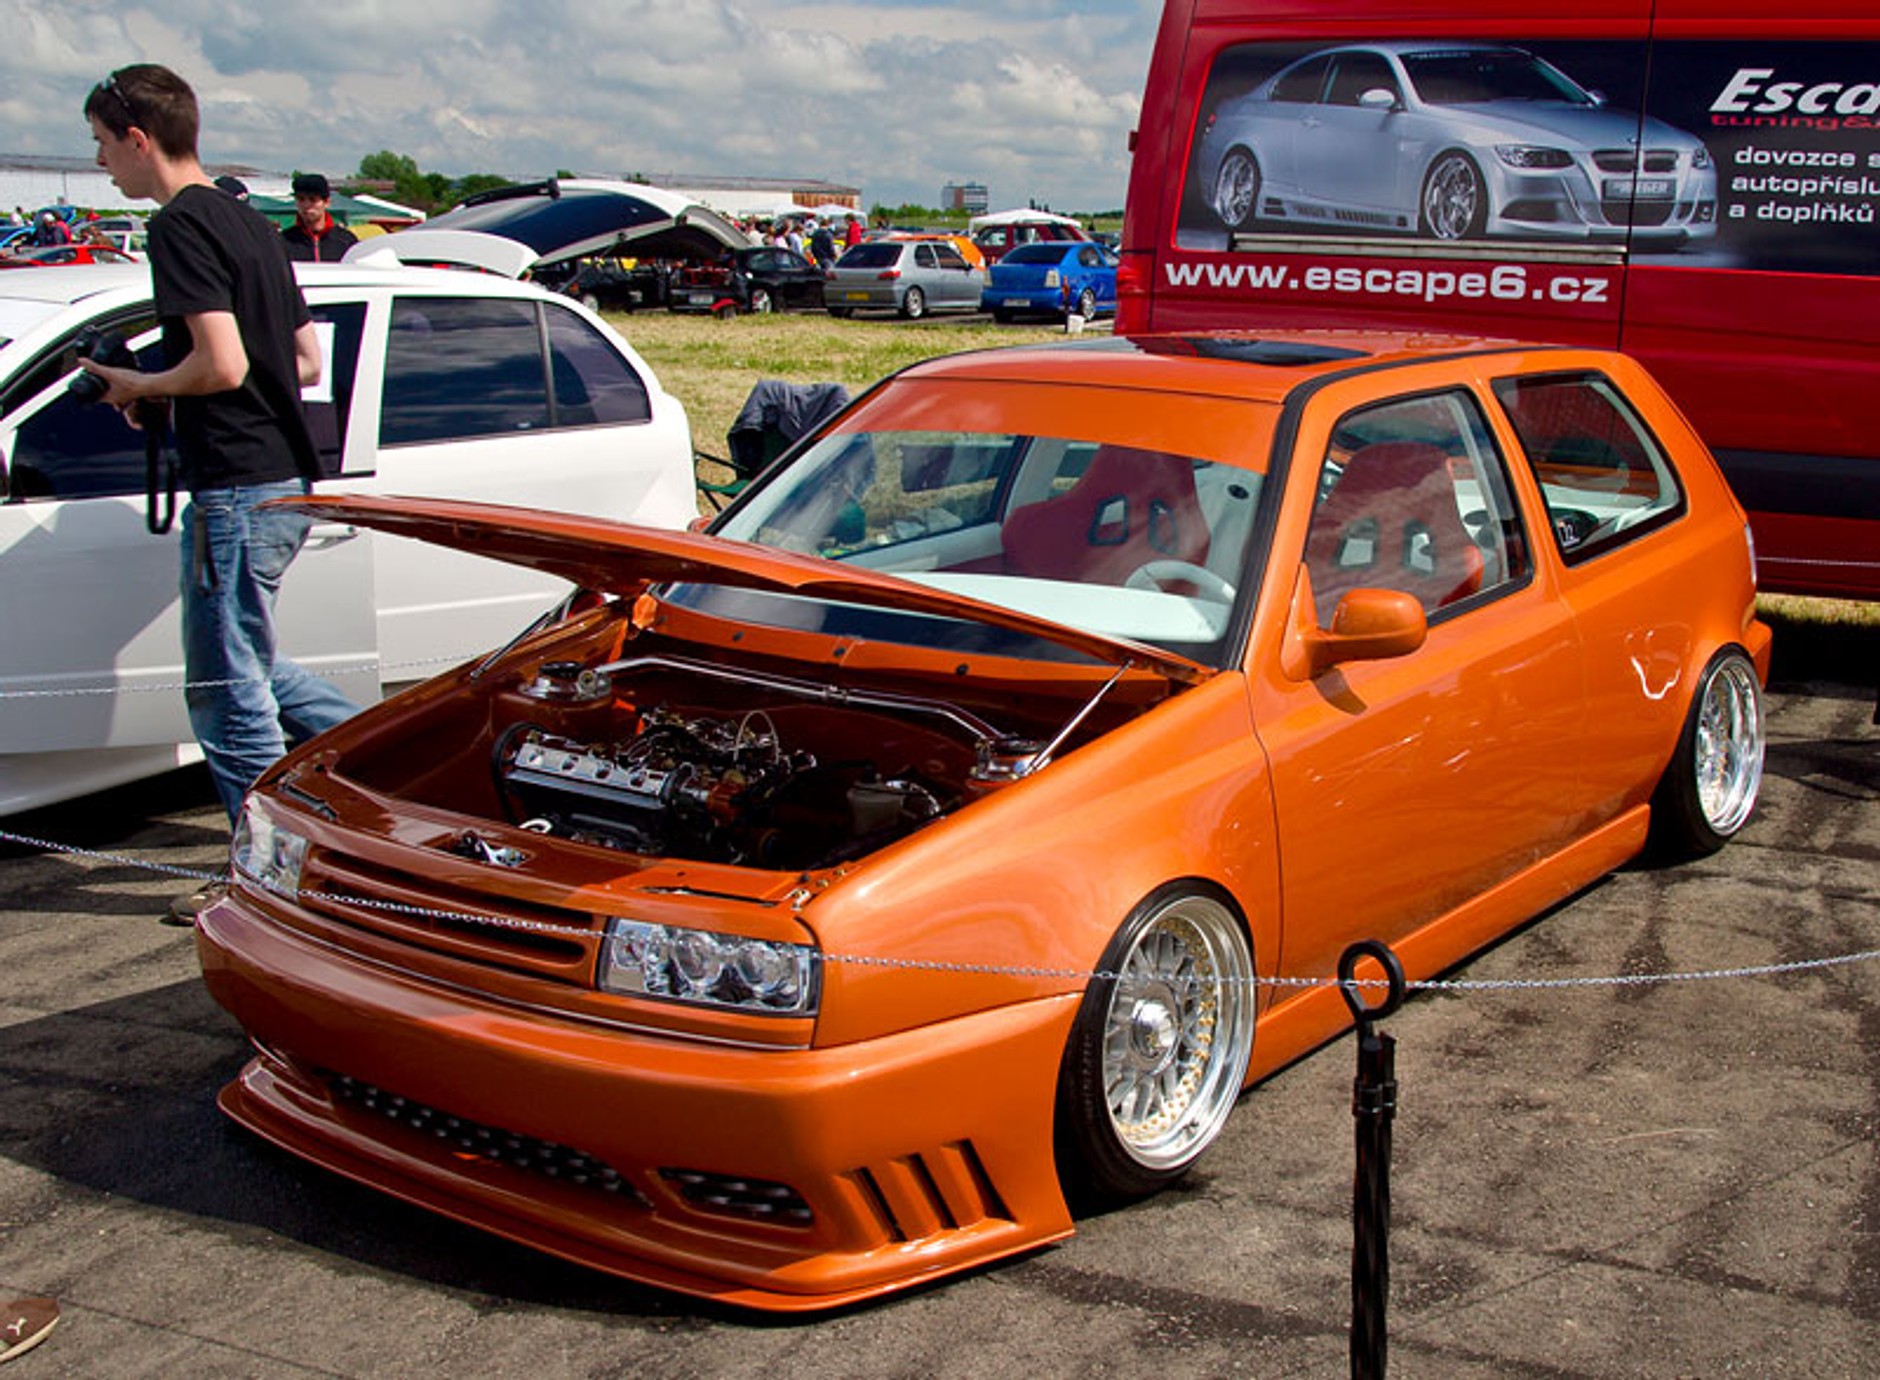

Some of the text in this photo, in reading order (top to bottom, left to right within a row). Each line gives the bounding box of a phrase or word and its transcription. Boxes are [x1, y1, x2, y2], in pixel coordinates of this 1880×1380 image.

[1709, 68, 1880, 114] Esca
[1711, 114, 1880, 131] tuning&
[1735, 145, 1856, 167] dovozce
[1729, 201, 1875, 224] a doplňků
[1165, 262, 1609, 303] www.escape6.cz
